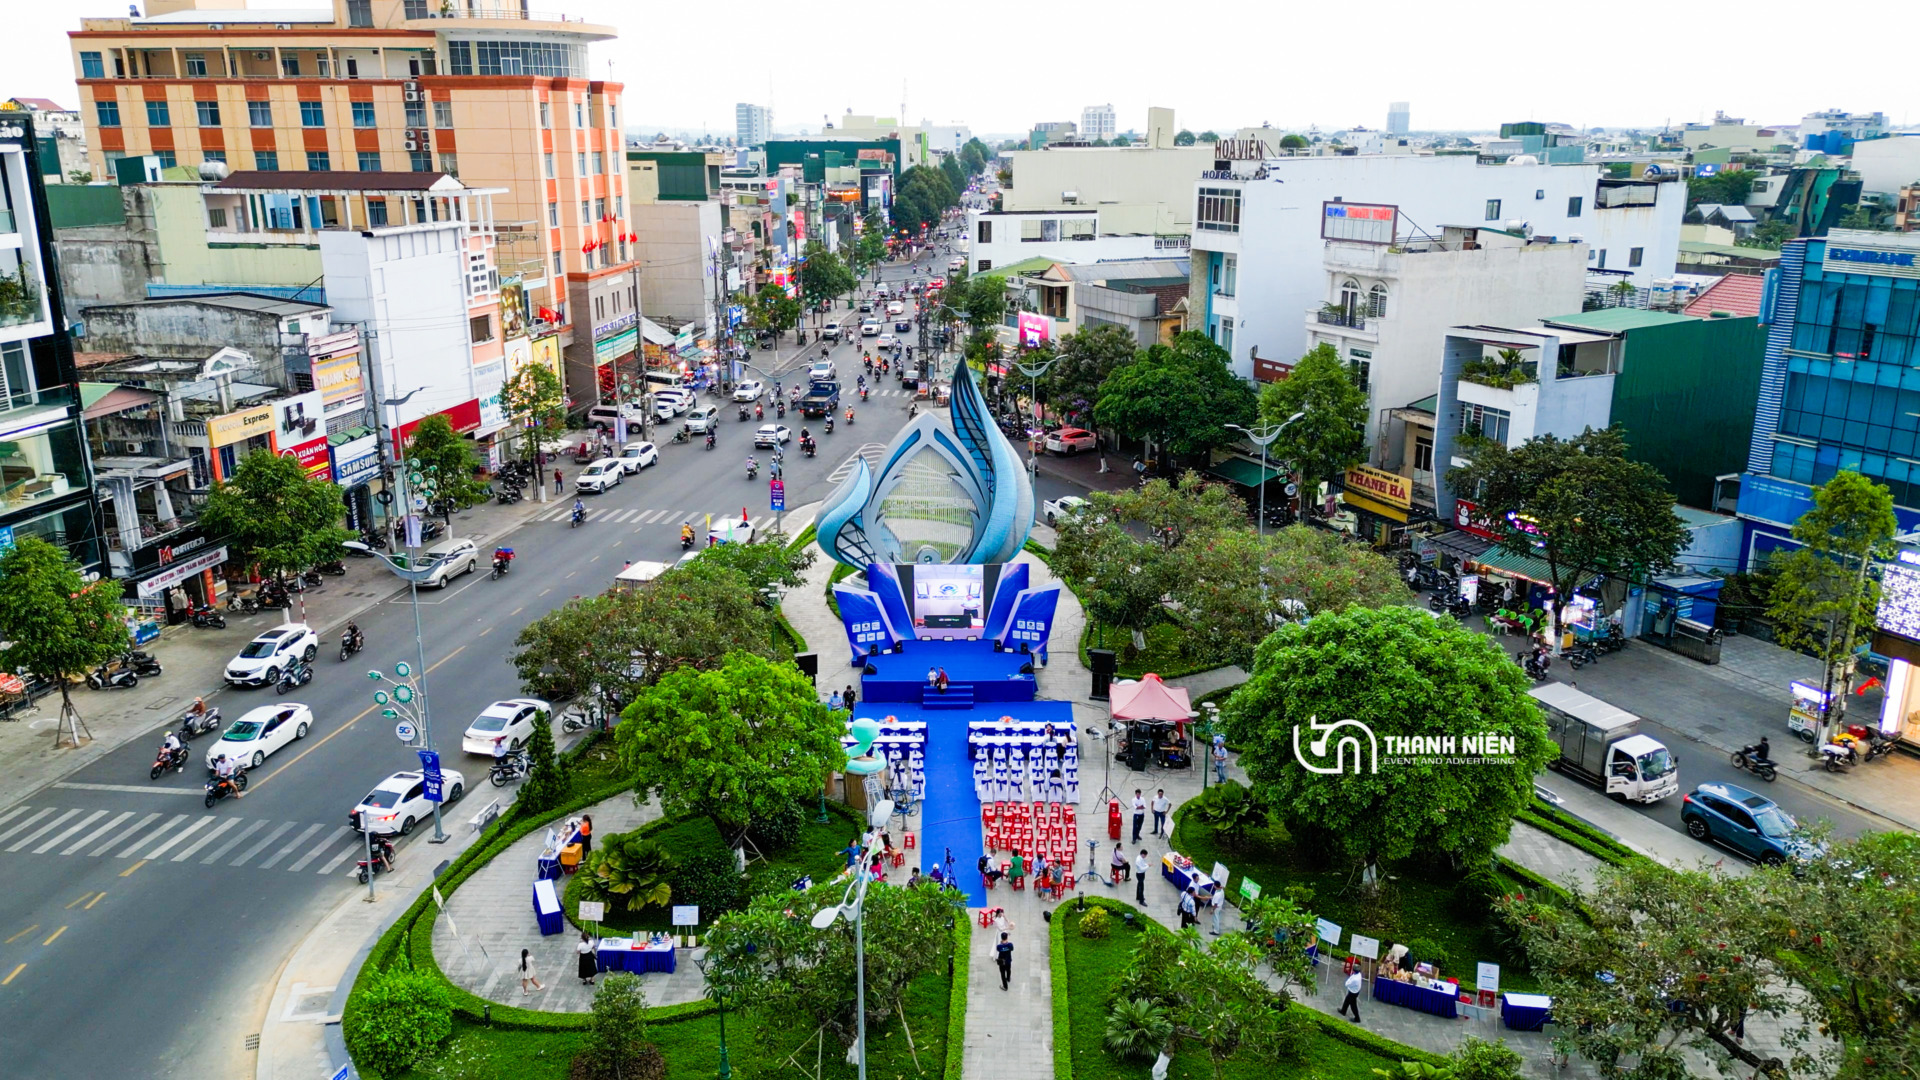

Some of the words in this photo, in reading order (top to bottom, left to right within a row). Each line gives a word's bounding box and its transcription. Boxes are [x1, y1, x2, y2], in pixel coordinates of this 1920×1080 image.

[1202, 170, 1233, 180] HOTEL
[243, 412, 270, 426] Express
[1348, 471, 1387, 495] THANH
[398, 726, 411, 734] 5G
